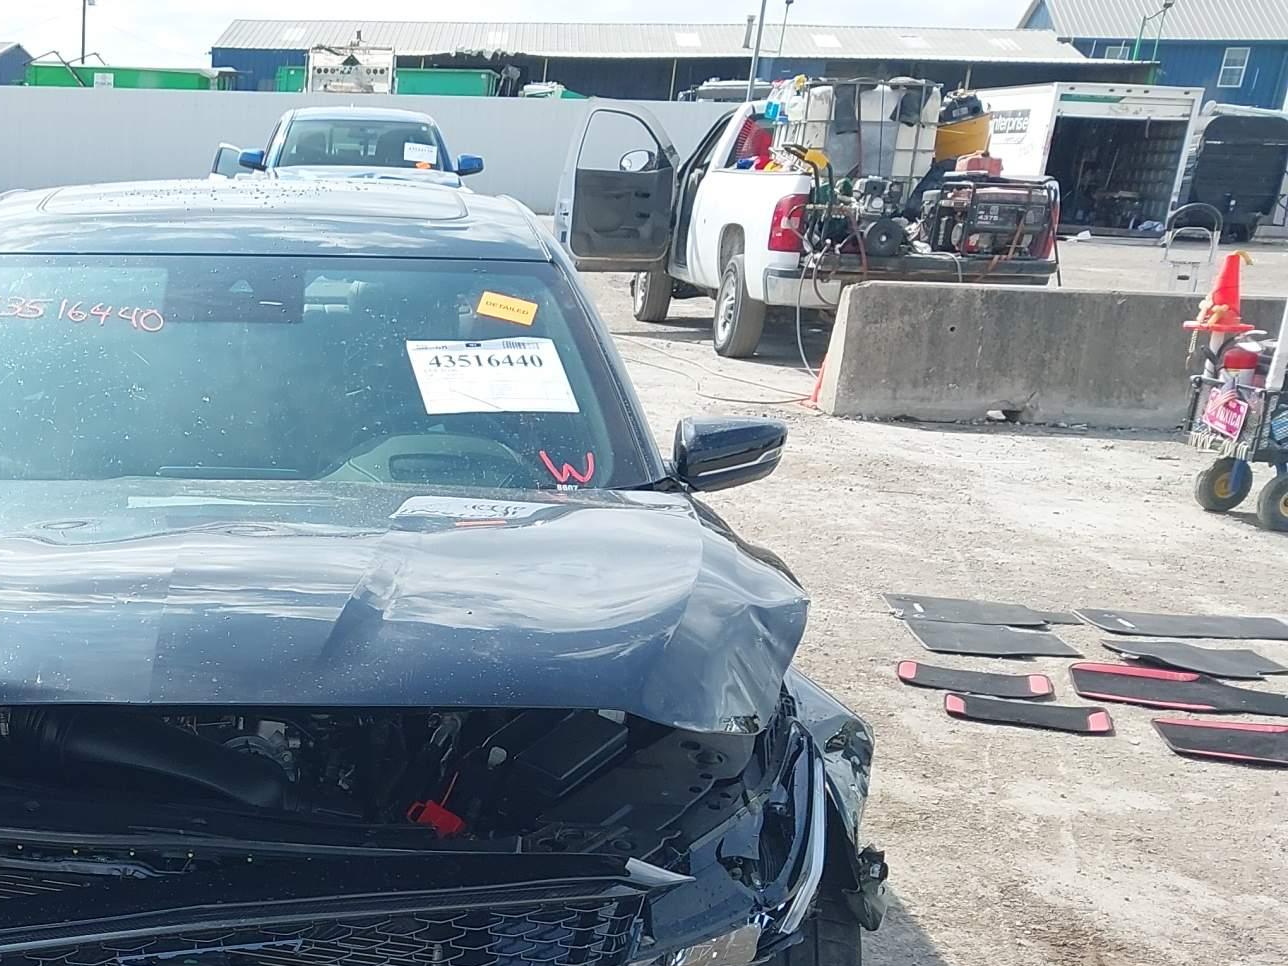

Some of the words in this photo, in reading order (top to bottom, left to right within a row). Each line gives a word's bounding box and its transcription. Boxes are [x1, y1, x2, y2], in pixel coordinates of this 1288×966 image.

[485, 301, 529, 316] DETAILED
[429, 354, 544, 368] 43516440
[538, 449, 595, 483] W
